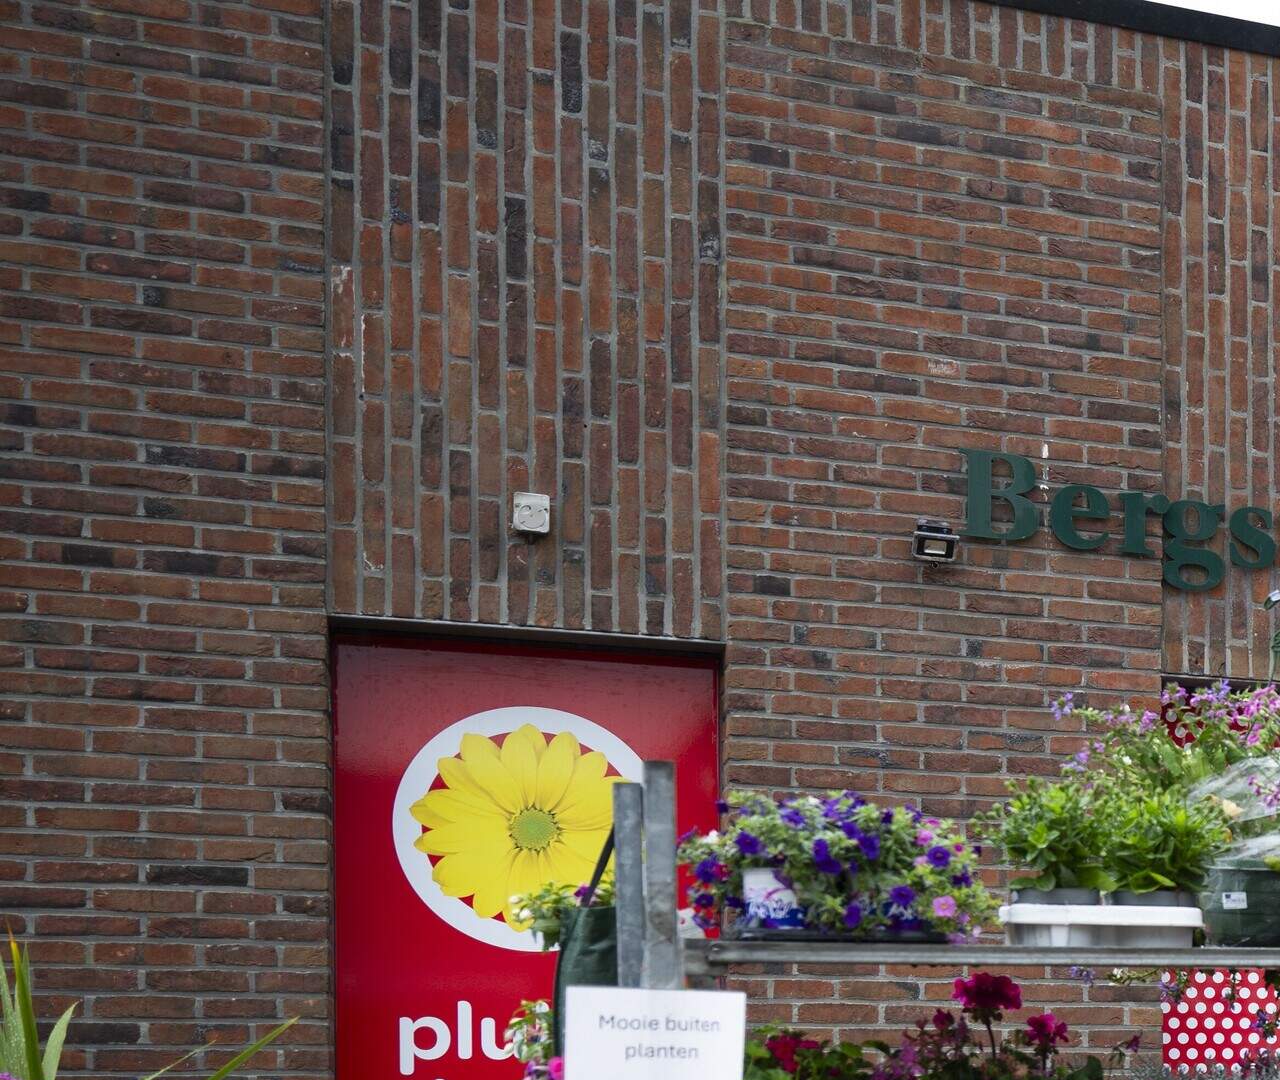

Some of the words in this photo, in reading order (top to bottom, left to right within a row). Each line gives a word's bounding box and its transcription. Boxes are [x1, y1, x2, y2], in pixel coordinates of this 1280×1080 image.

[599, 1015, 659, 1031] Mooie
[665, 1016, 720, 1032] buiten
[625, 1043, 699, 1060] planten
